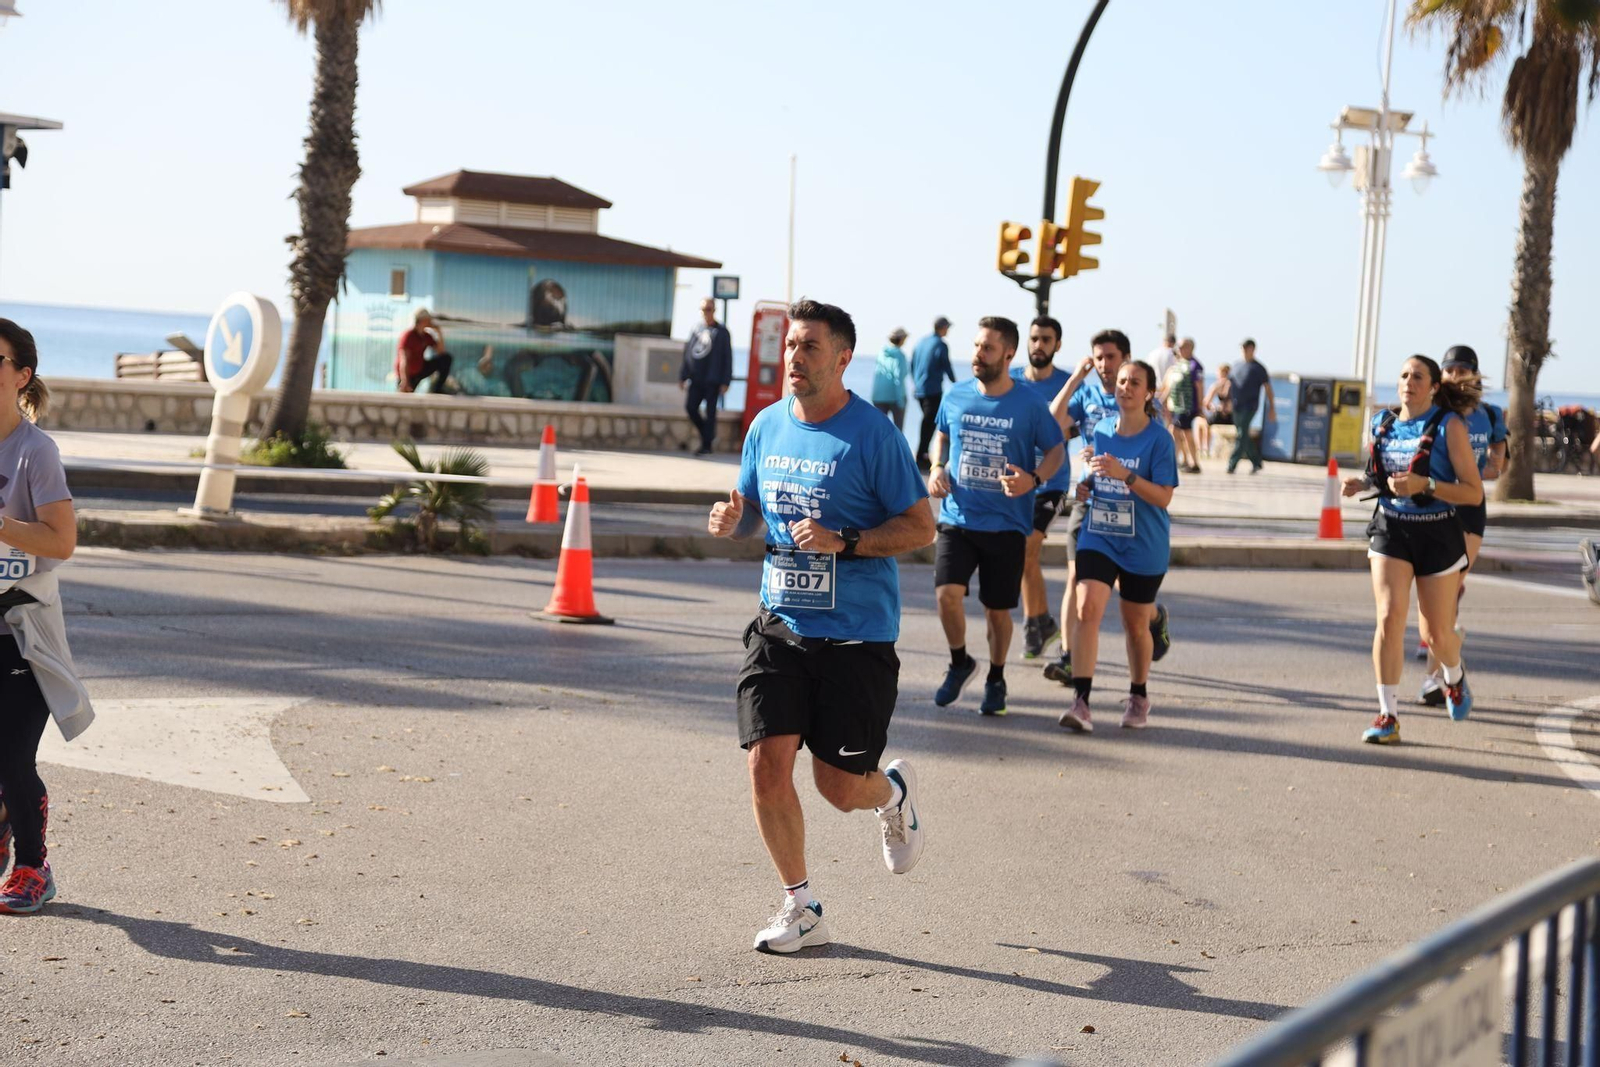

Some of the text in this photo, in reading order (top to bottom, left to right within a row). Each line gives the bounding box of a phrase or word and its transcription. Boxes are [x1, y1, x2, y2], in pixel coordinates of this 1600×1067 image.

[962, 413, 1013, 429] mayoral
[765, 455, 837, 477] mayoral
[965, 466, 998, 479] 1654
[1102, 512, 1118, 523] 12
[1400, 512, 1448, 522] ARMOUR
[0, 560, 25, 579] 00
[775, 572, 824, 590] 1607
